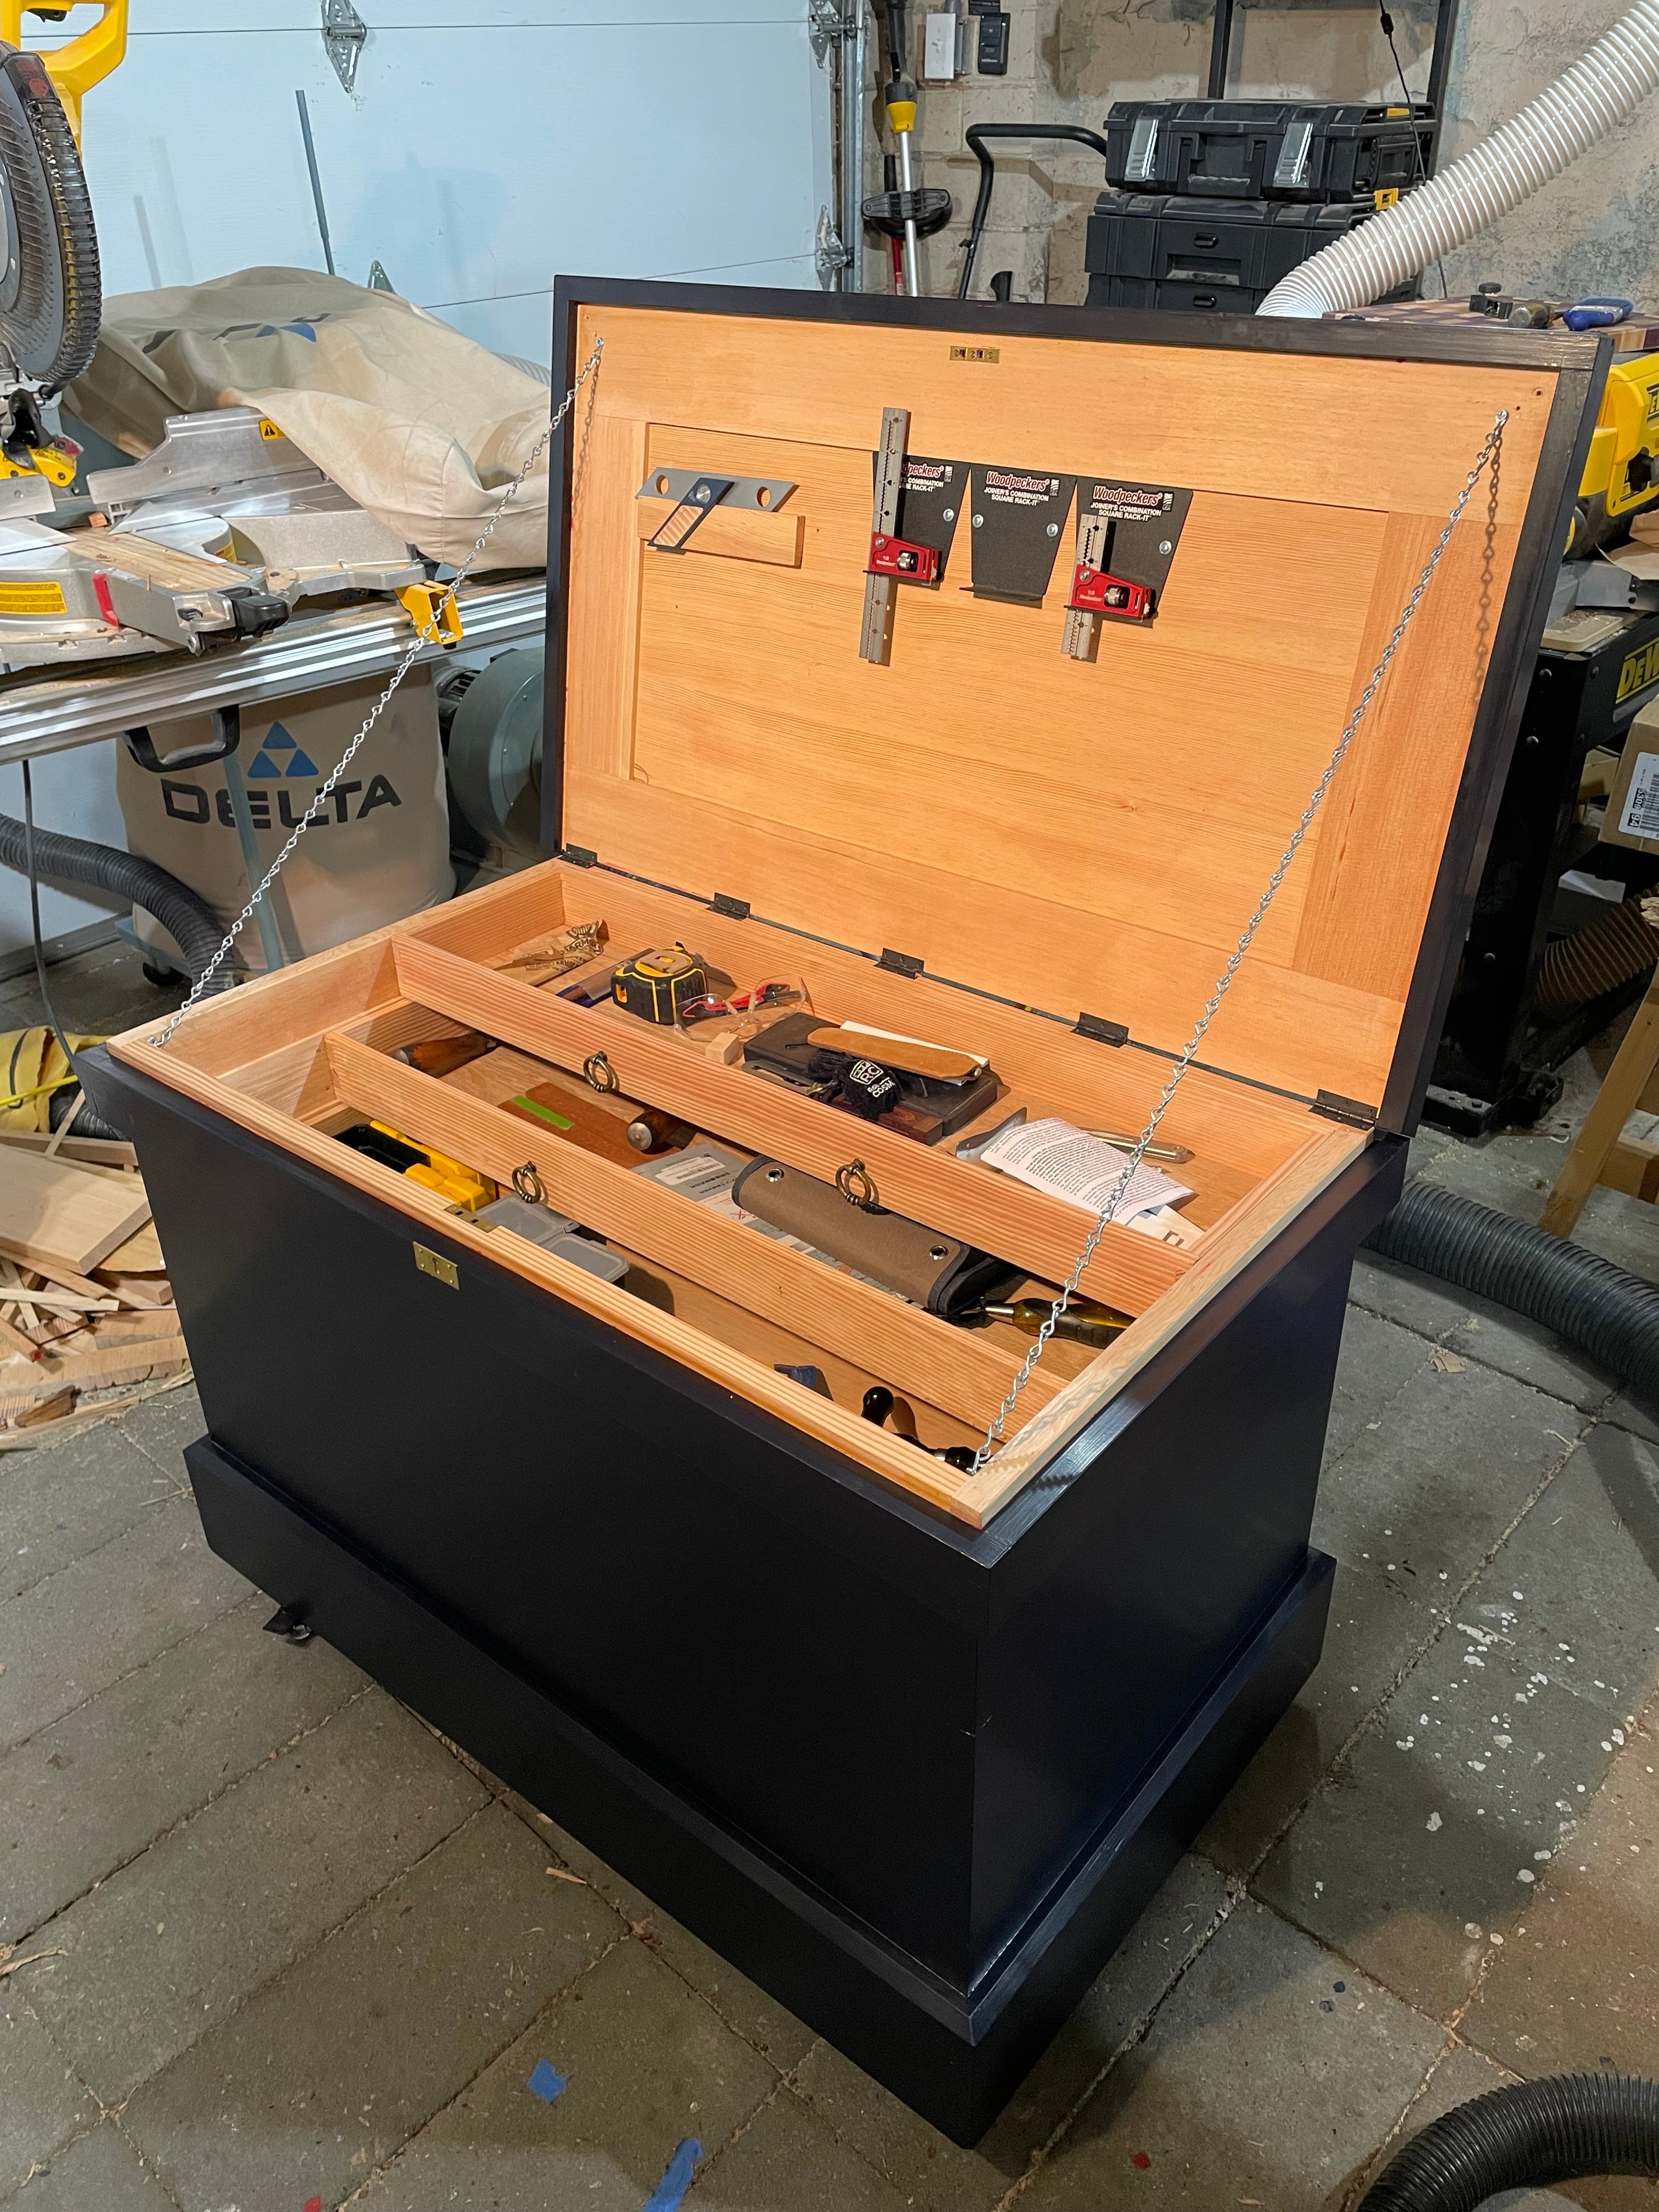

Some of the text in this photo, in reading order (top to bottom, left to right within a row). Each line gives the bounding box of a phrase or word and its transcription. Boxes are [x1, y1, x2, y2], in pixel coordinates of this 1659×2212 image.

[902, 462, 942, 478] dpeckers
[908, 478, 944, 488] COMBINATION
[986, 471, 1047, 492] Woodpeckers
[984, 487, 1049, 501] JOINER'S COMBINATION
[991, 494, 1039, 506] SQUARE RACK-IT
[1093, 485, 1159, 506] Woodpeckers
[1091, 502, 1162, 516] JOINER'S COMBINATION
[1098, 509, 1150, 521] SQUARE RACK-IT
[161, 774, 402, 828] DELTA
[1629, 813, 1641, 827] 94
